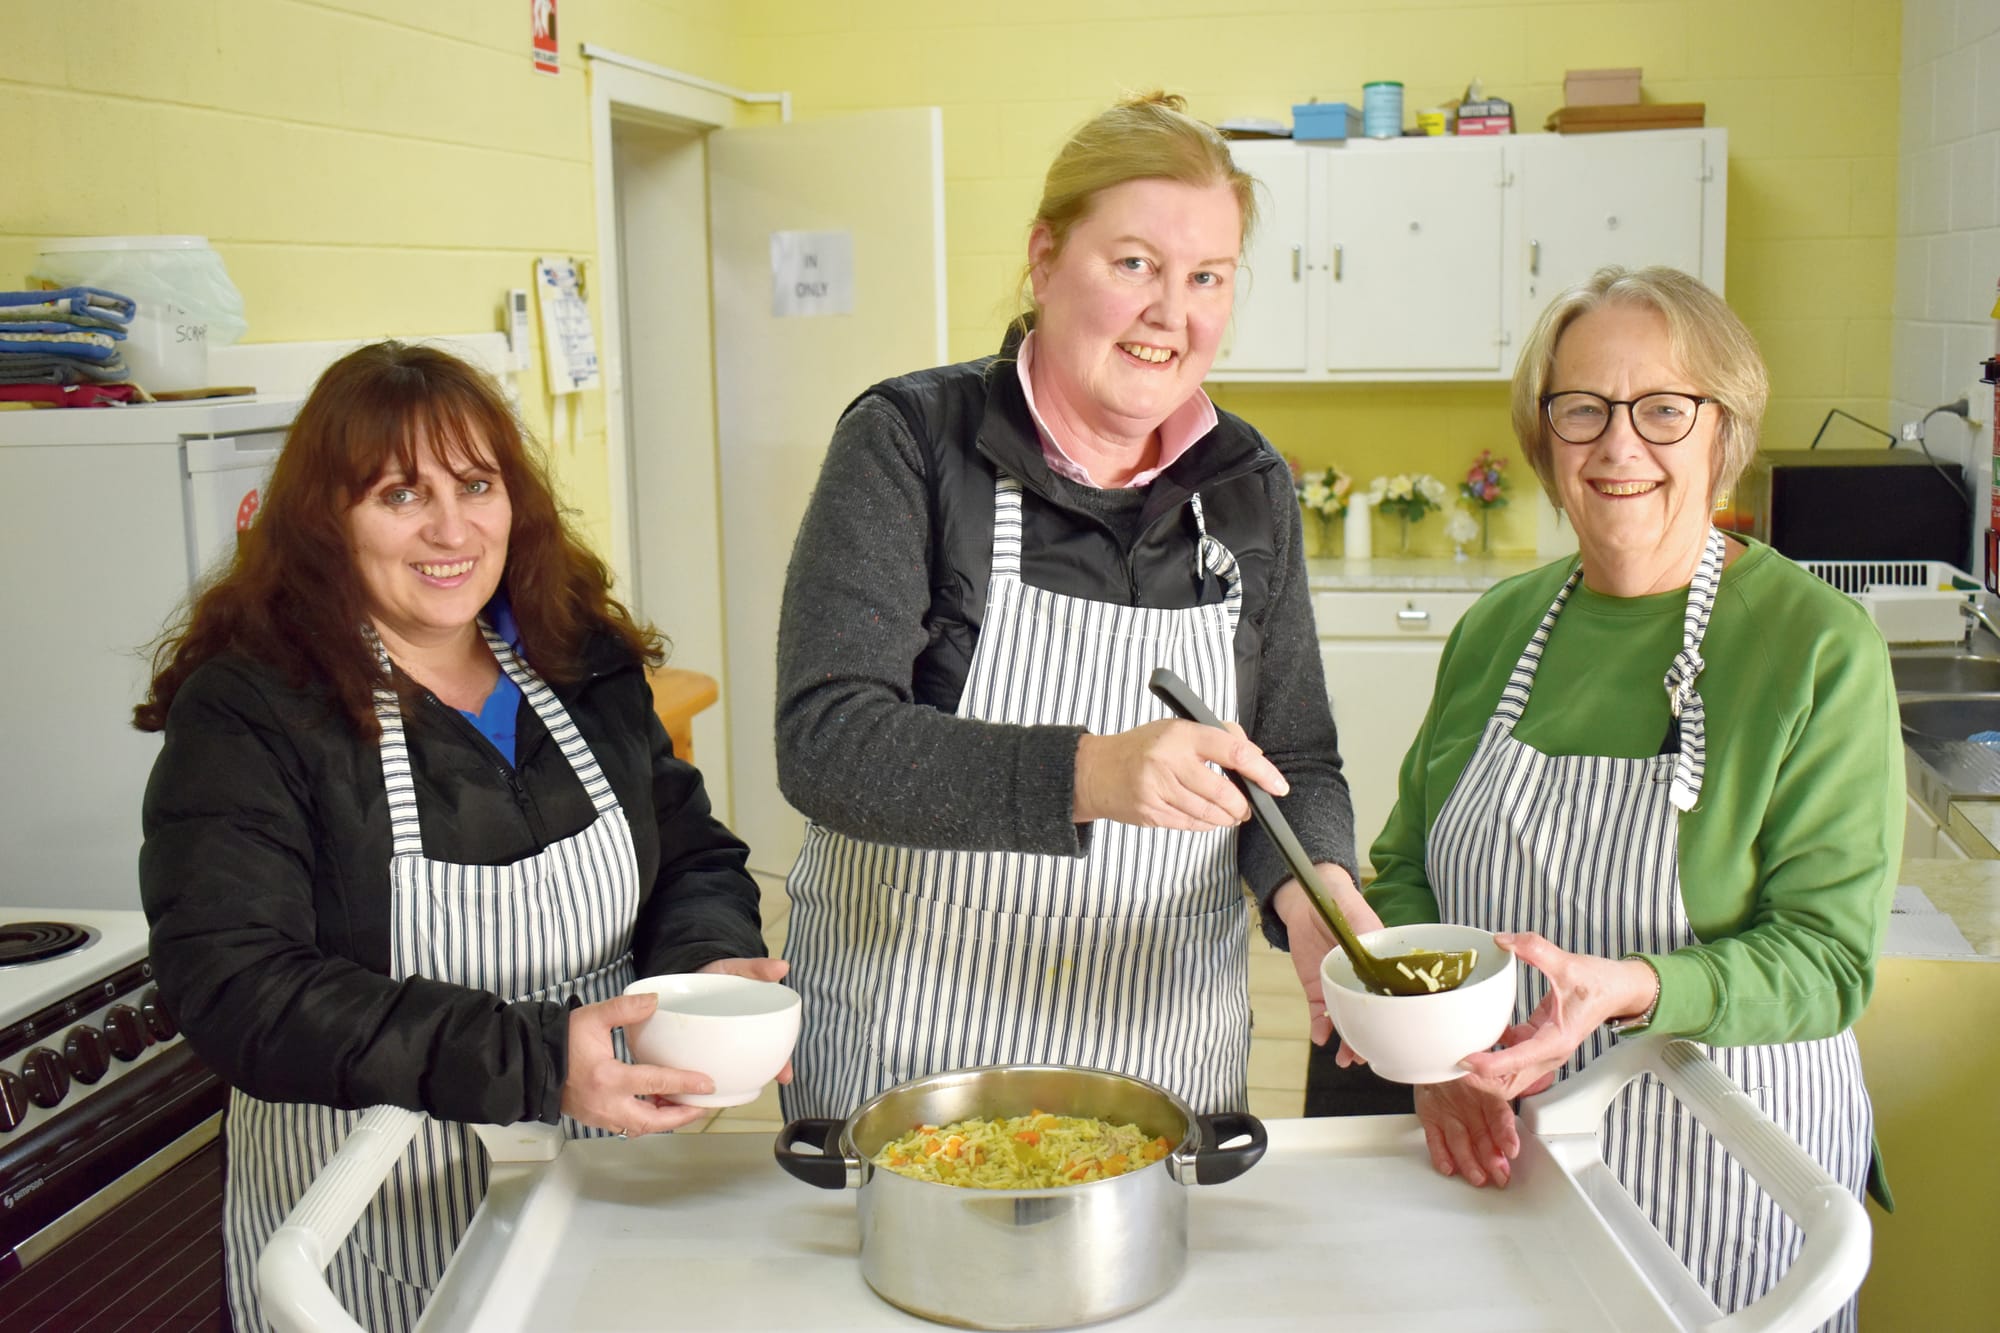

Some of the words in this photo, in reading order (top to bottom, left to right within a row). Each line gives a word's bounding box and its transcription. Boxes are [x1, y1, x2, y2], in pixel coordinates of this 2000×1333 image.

[804, 255, 818, 269] IN
[796, 282, 828, 298] ONLY
[13, 1178, 44, 1200] SIMPSON
